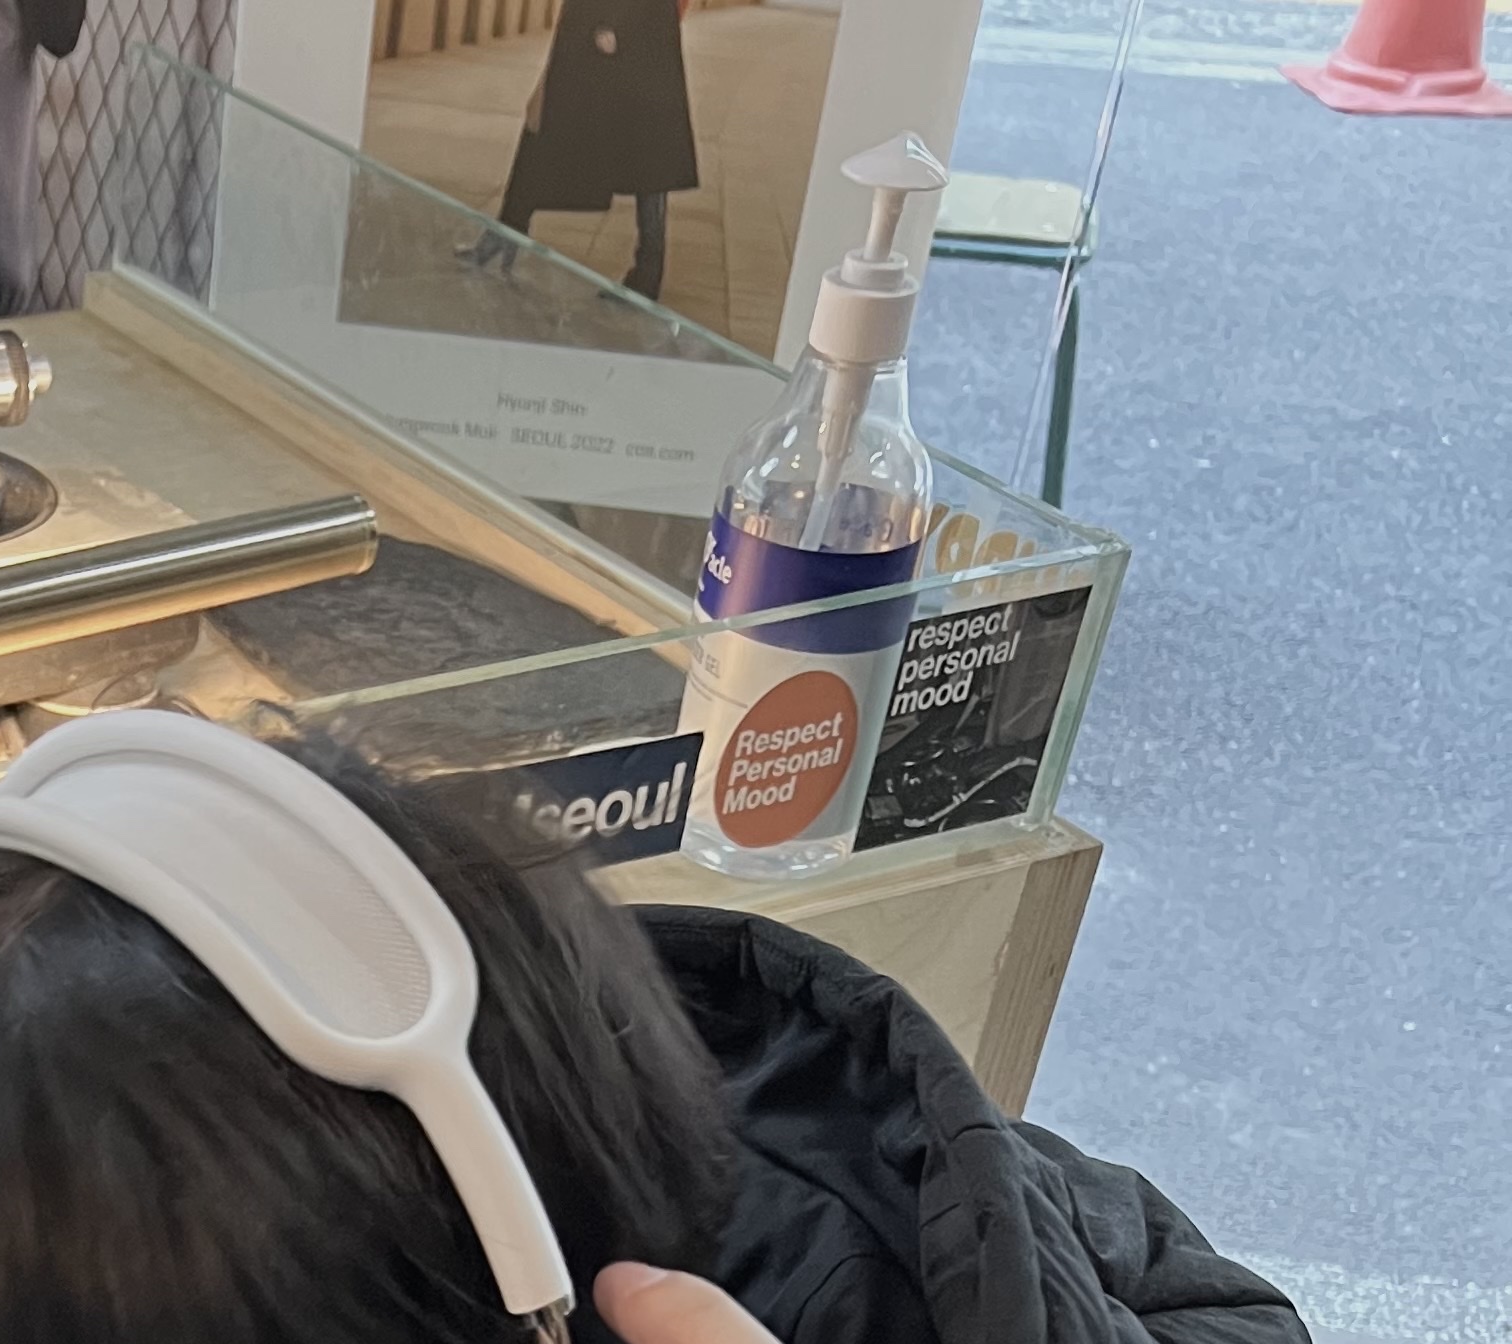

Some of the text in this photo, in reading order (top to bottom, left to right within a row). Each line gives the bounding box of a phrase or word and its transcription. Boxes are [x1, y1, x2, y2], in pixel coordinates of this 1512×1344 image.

[907, 601, 1013, 652] respect
[898, 630, 1021, 691] personal
[890, 671, 974, 717] mood
[735, 712, 843, 758] Respect
[728, 738, 844, 787] Personal
[722, 775, 798, 815] Mood
